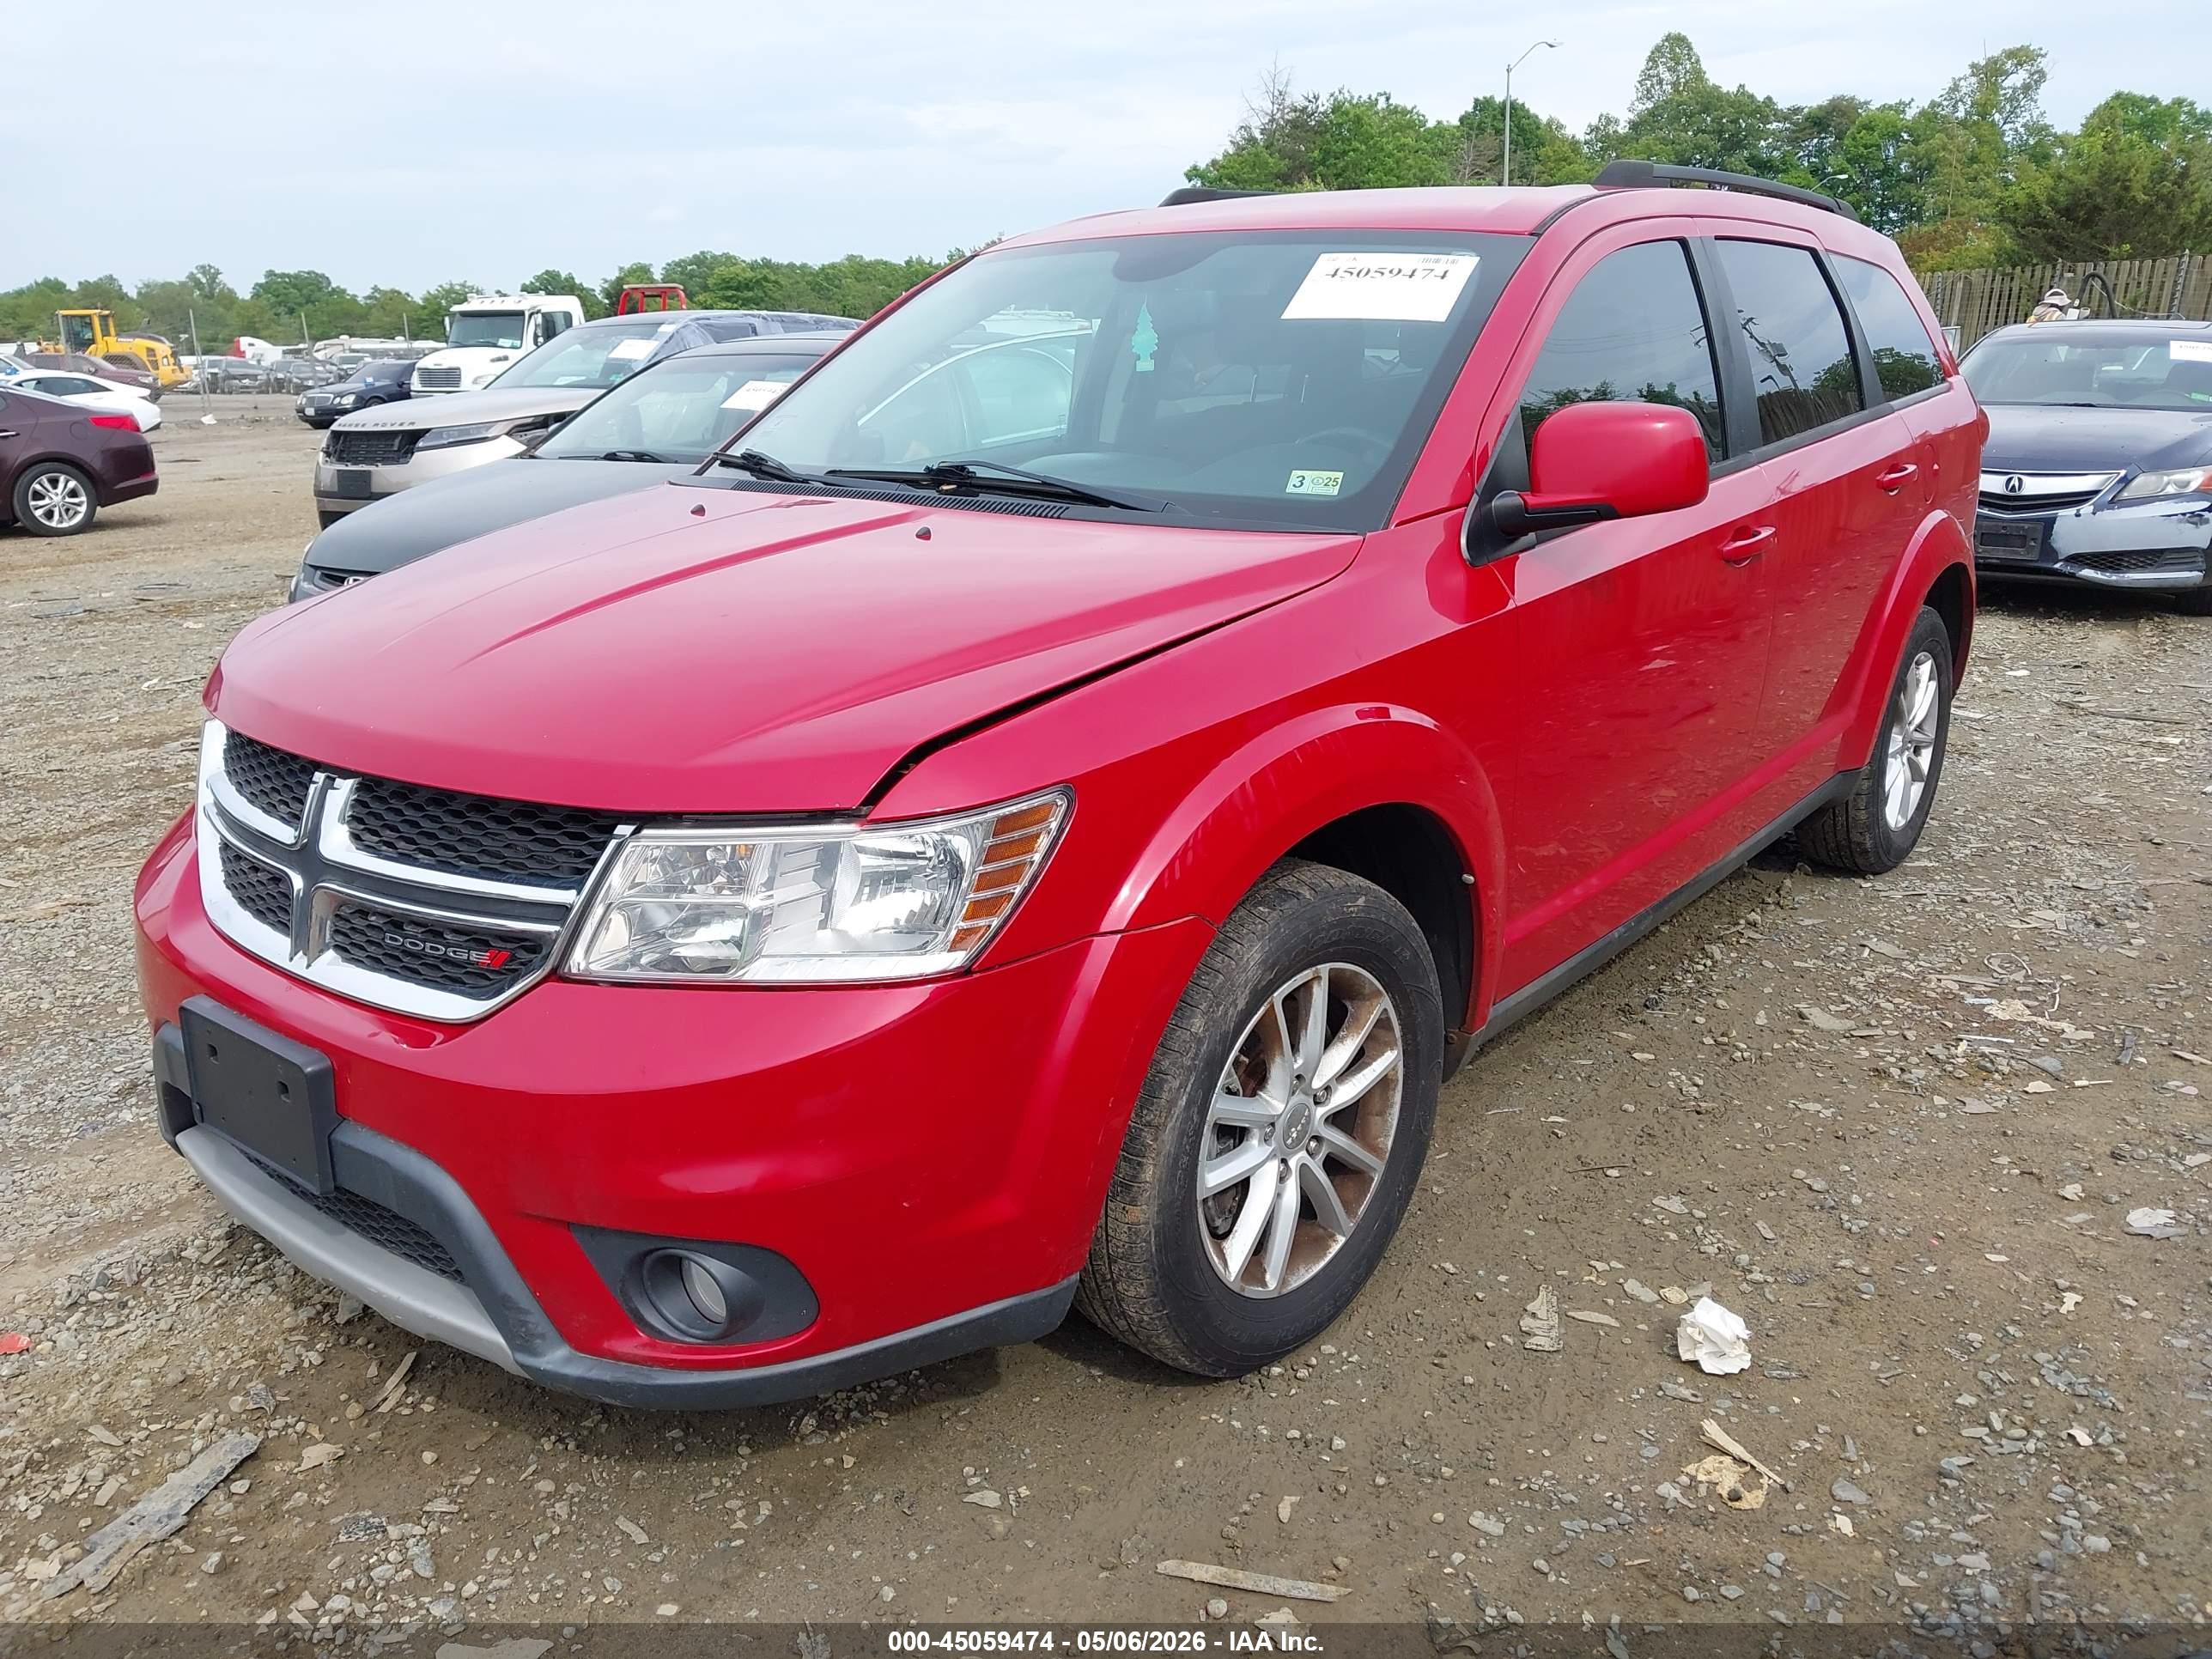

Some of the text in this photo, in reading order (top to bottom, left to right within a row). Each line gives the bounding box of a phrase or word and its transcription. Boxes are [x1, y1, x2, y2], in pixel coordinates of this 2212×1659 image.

[1325, 267, 1449, 280] 45059474
[1292, 475, 1340, 489] 3 25
[384, 933, 491, 963] DODGE
